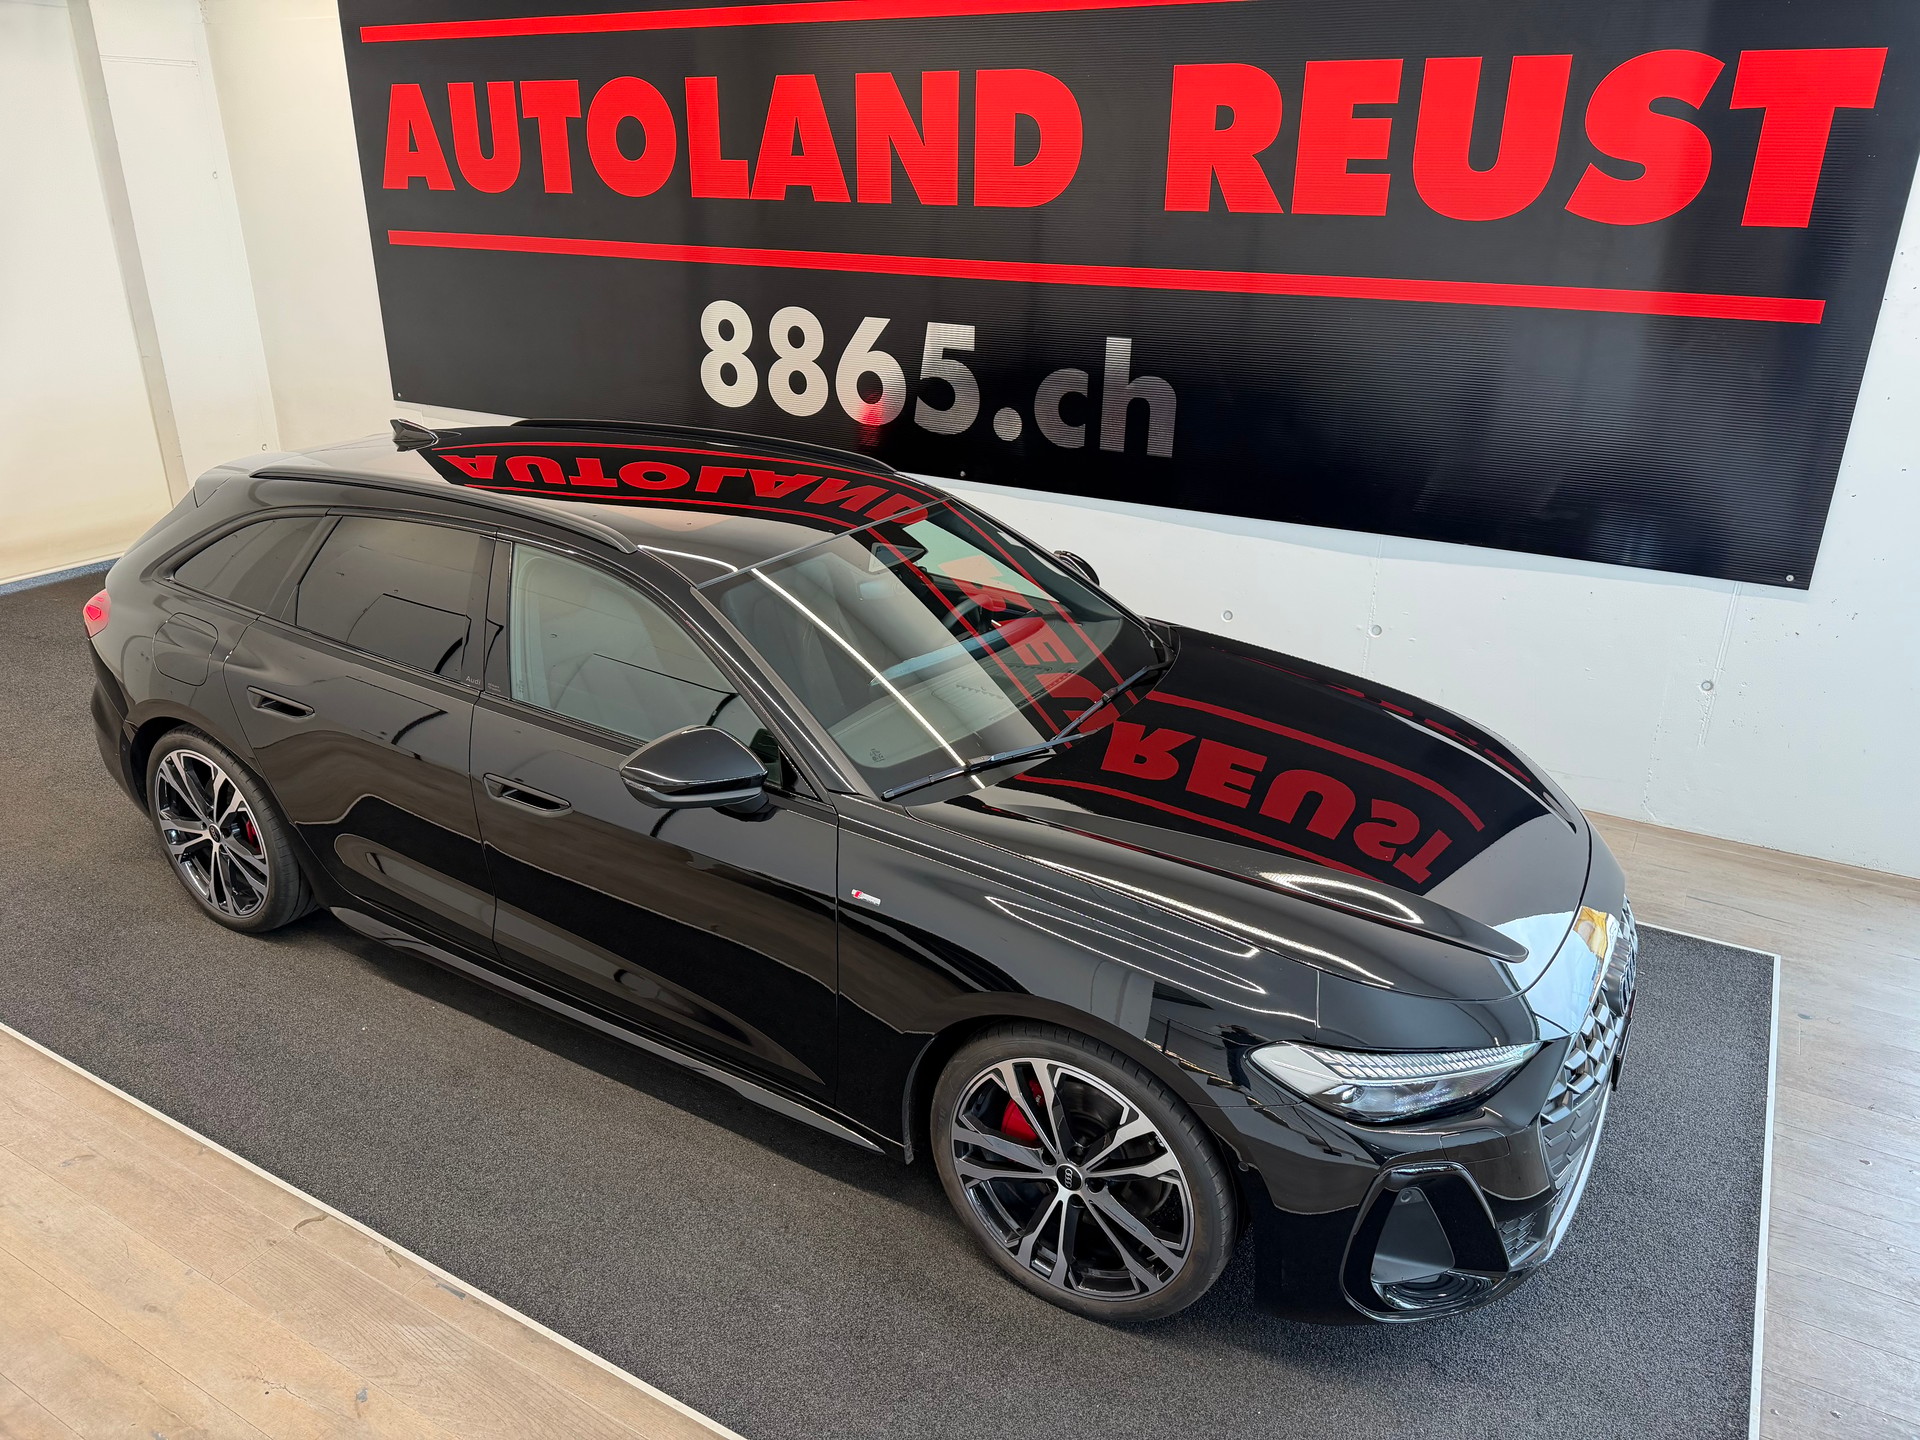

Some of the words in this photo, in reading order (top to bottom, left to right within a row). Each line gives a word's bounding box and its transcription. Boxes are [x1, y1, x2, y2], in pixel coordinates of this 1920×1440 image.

[382, 69, 1084, 208] AUTOLAND
[1163, 46, 1889, 229] REUST
[700, 299, 1177, 458] 8865.ch
[465, 675, 481, 686] Audi
